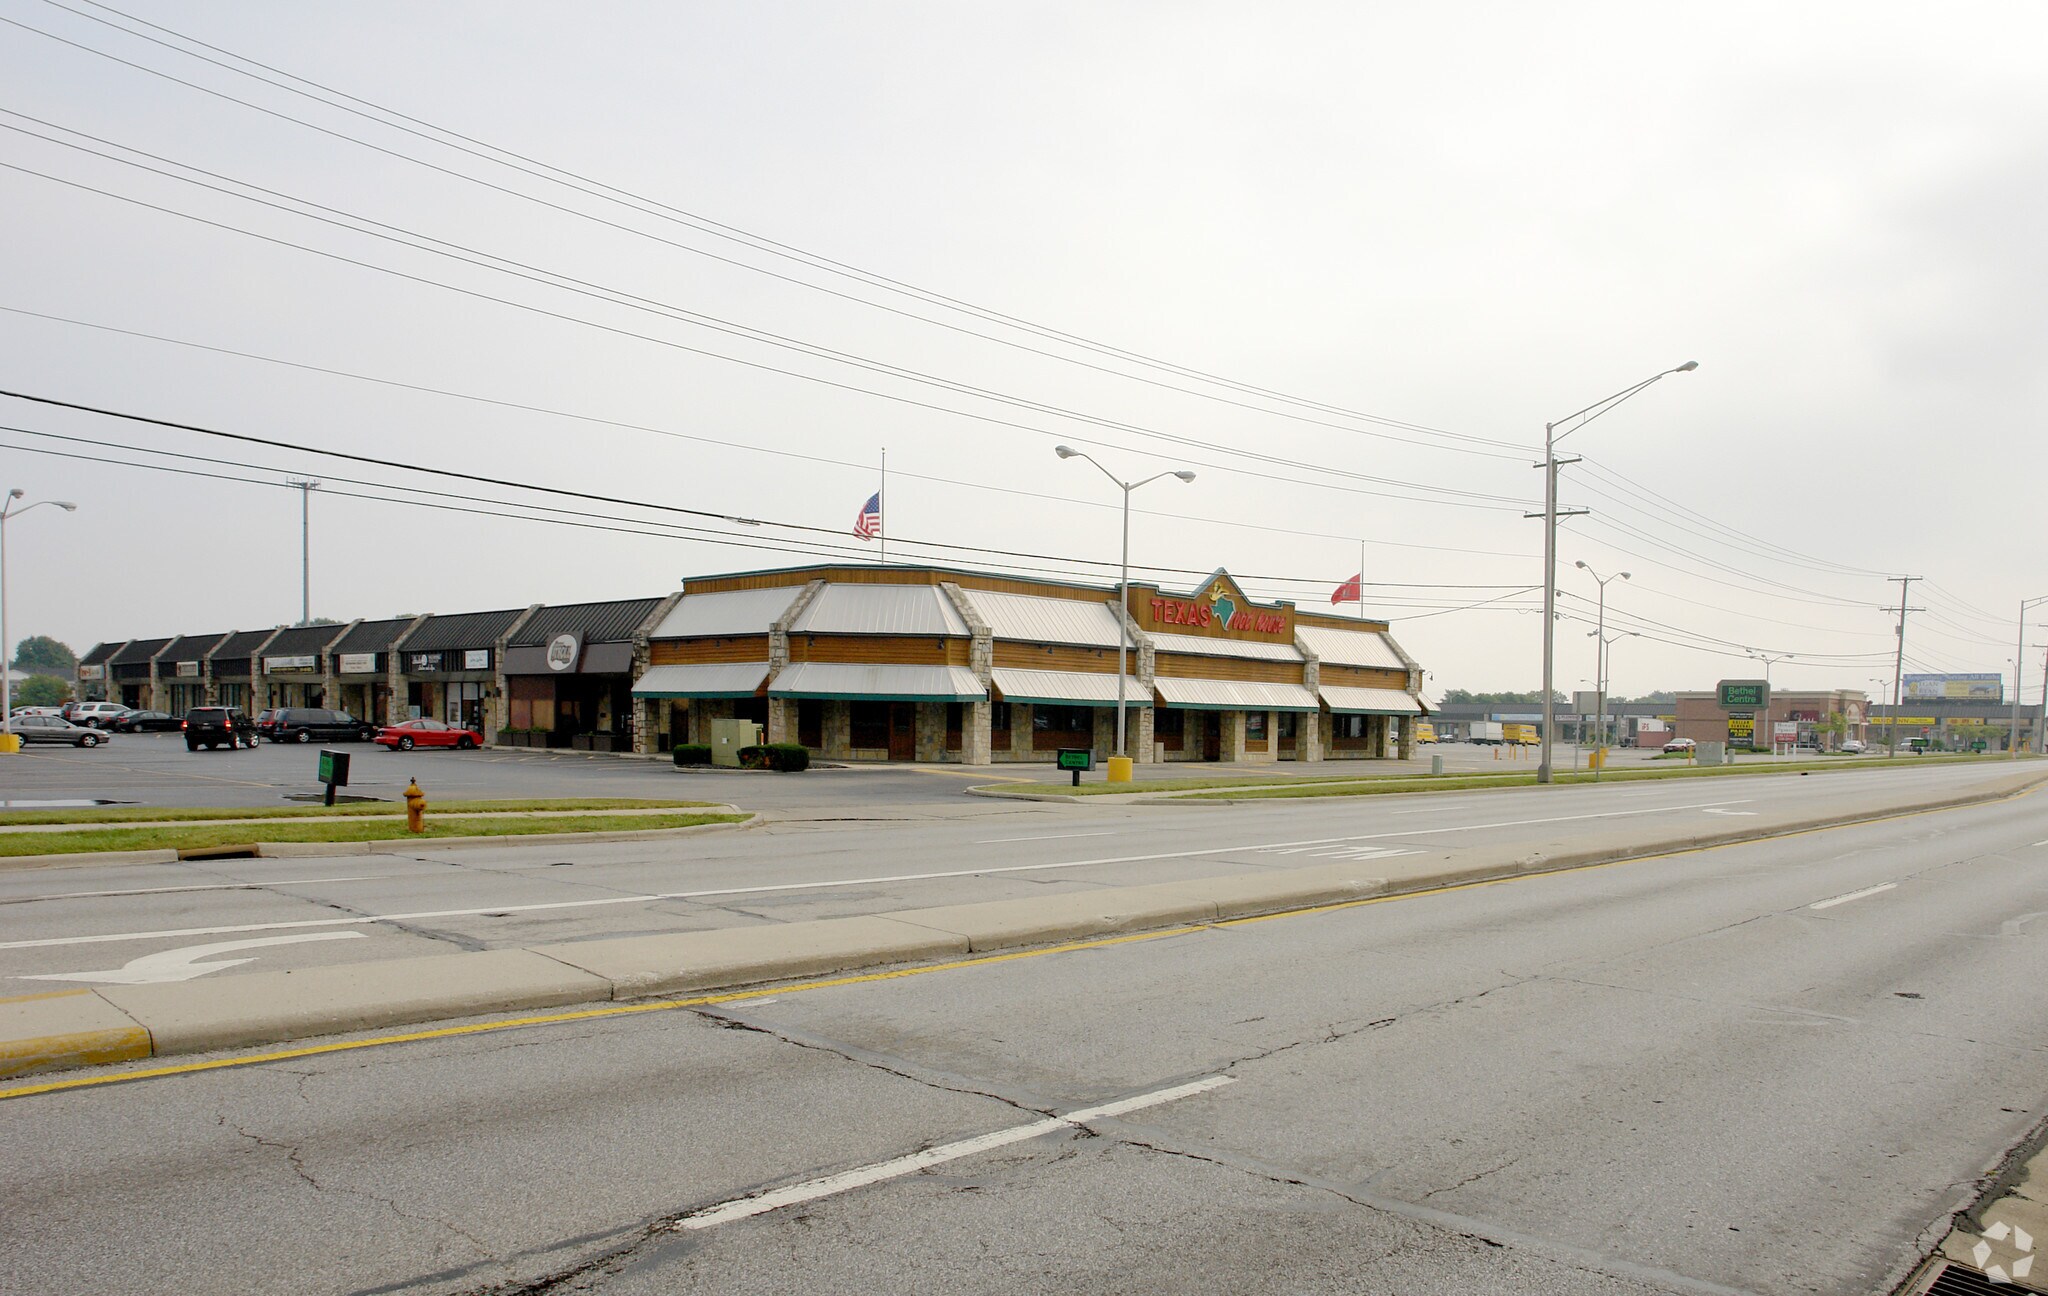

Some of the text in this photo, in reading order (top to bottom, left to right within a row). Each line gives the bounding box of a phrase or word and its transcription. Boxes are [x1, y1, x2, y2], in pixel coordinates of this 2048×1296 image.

[1151, 599, 1212, 628] TEXAS
[1728, 686, 1756, 695] Bethel
[1727, 695, 1757, 703] Centre
